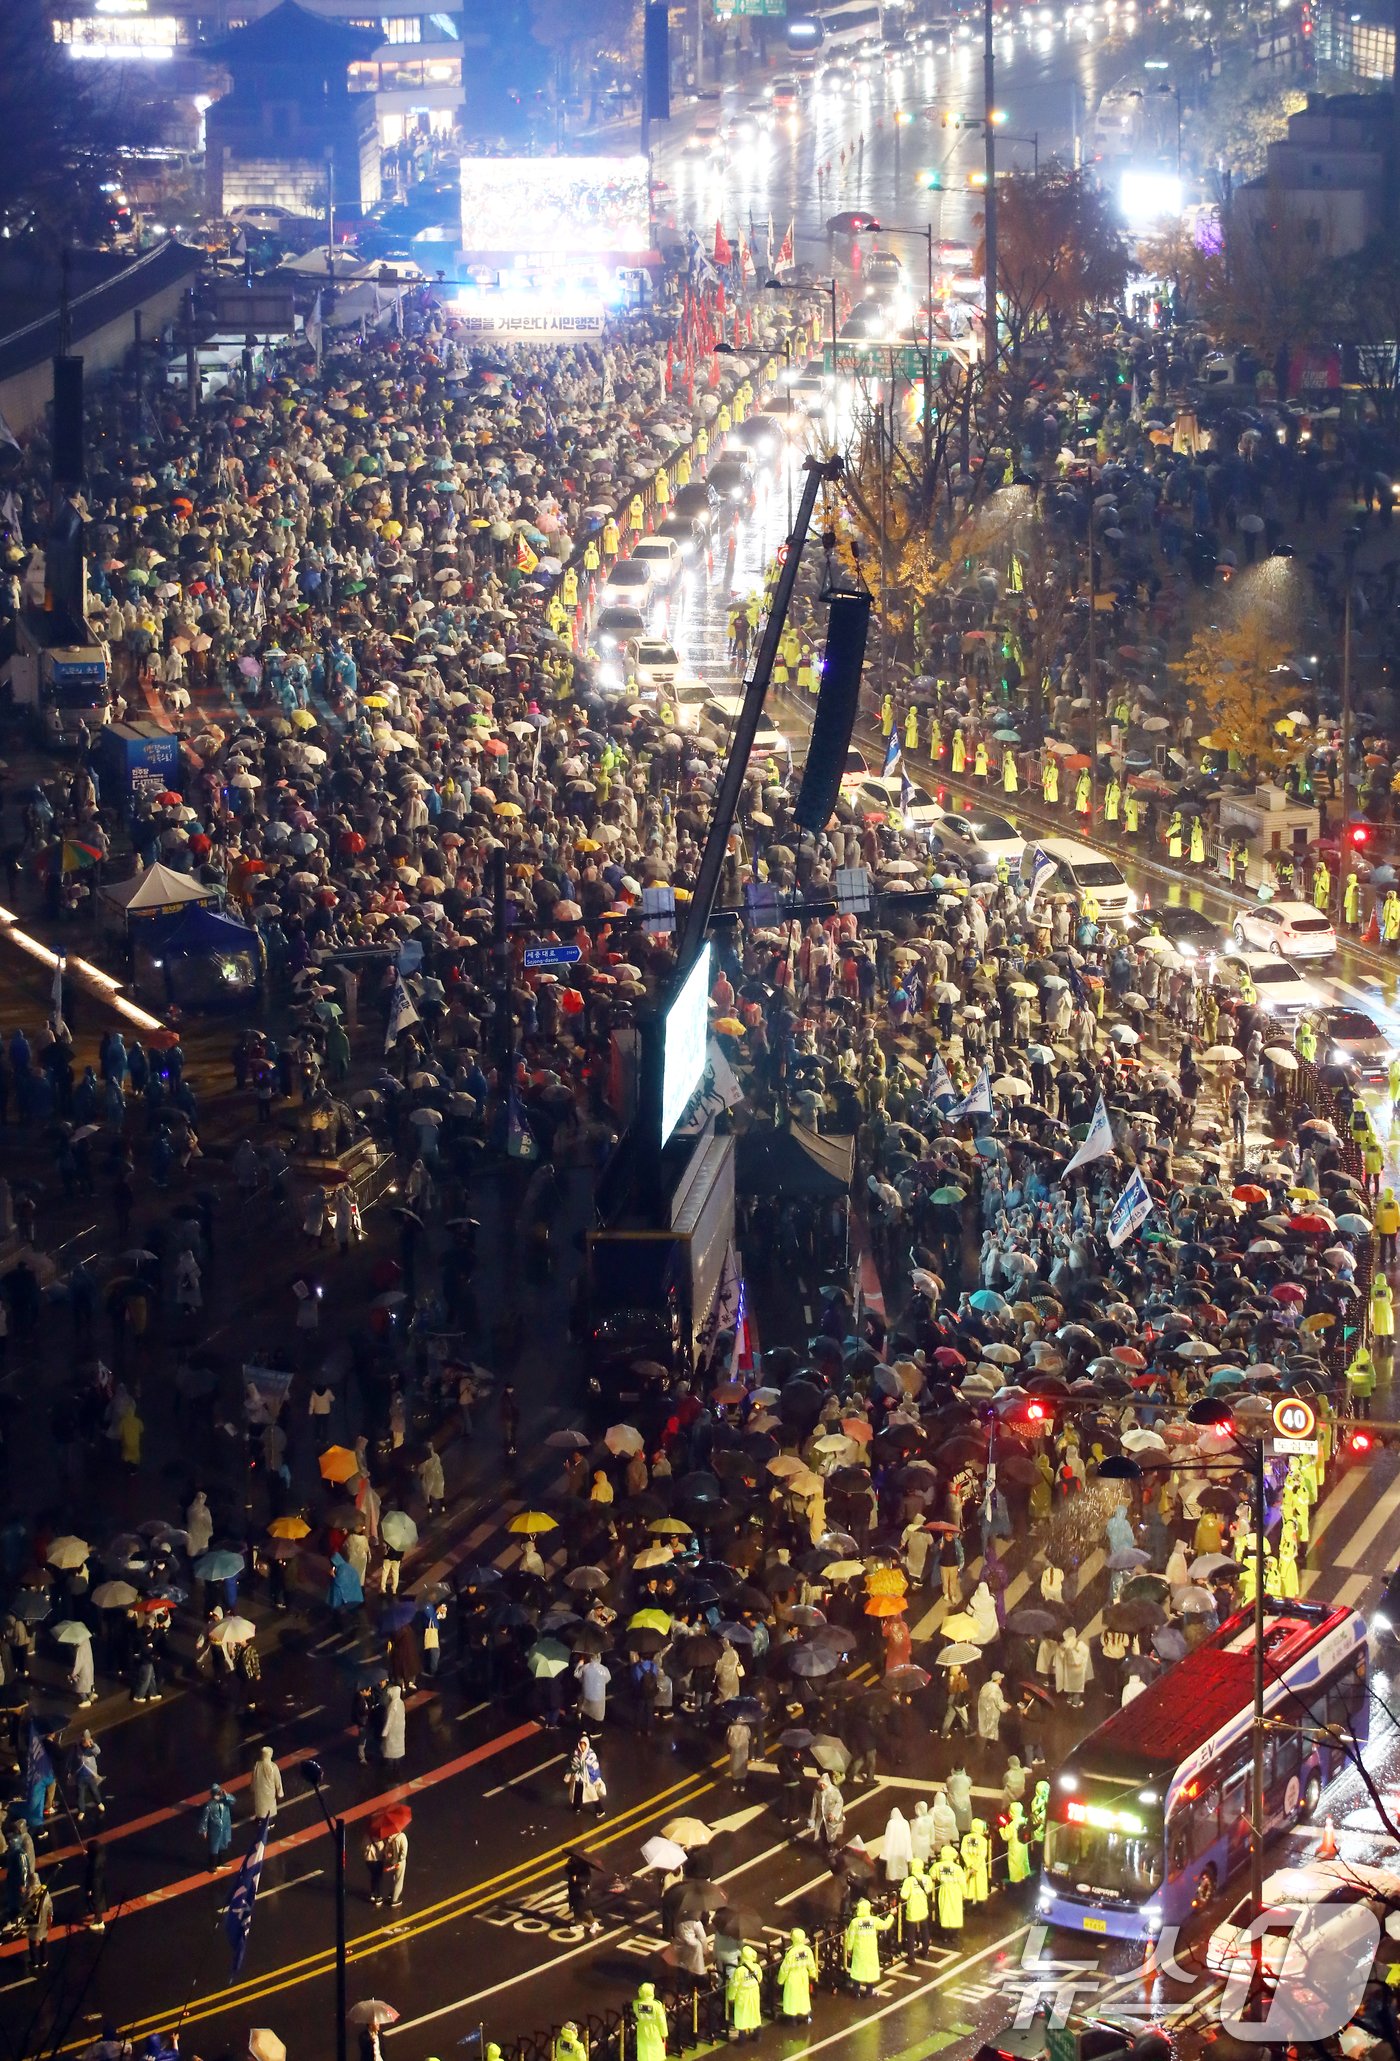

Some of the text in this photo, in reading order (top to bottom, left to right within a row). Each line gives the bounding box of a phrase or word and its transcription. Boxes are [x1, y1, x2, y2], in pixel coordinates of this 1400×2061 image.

[447, 316, 599, 331] 석열을 거부한다 시민행진
[527, 950, 556, 959] 세종대로
[526, 957, 558, 965] Sejong-daero
[1282, 1408, 1306, 1429] 40
[1278, 1441, 1314, 1451] 도심부
[1198, 1738, 1217, 1768] EV
